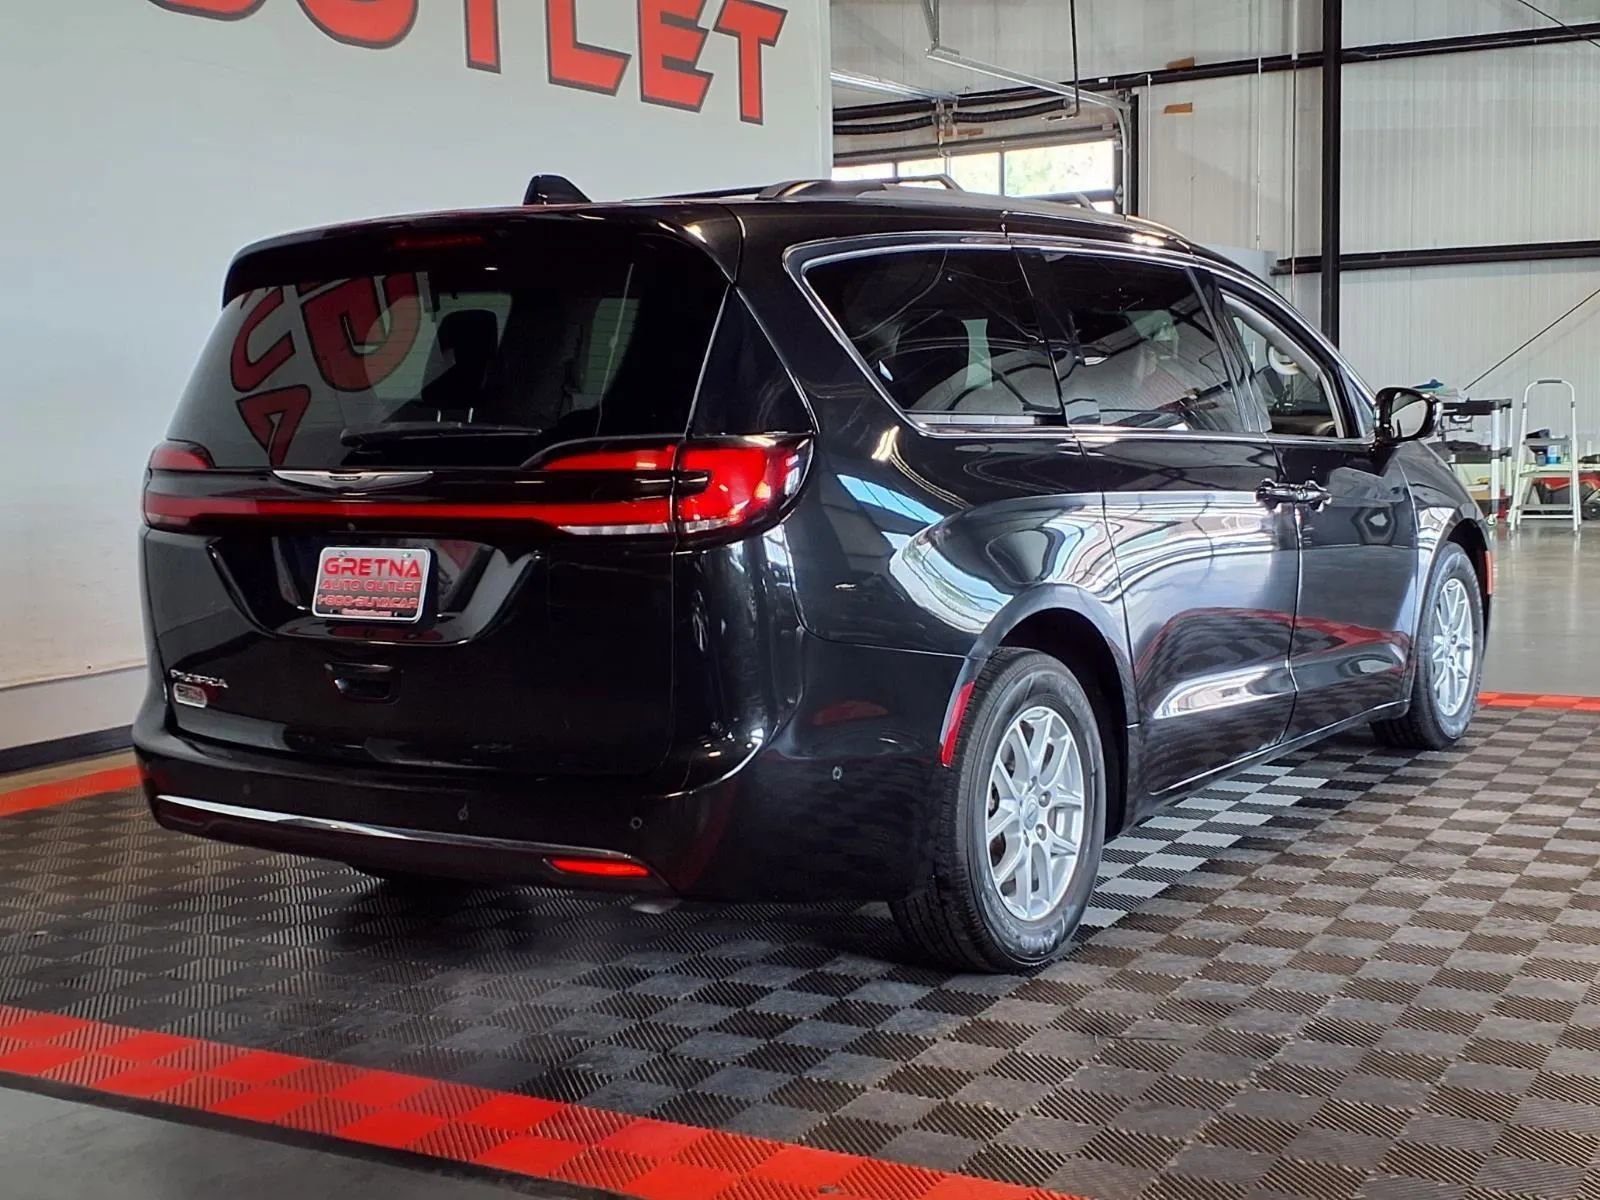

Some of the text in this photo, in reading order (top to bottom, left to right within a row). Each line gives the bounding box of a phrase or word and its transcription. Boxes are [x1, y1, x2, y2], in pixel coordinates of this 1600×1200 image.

[323, 557, 422, 578] GRETNA
[320, 579, 422, 593] AUTO OUTLET
